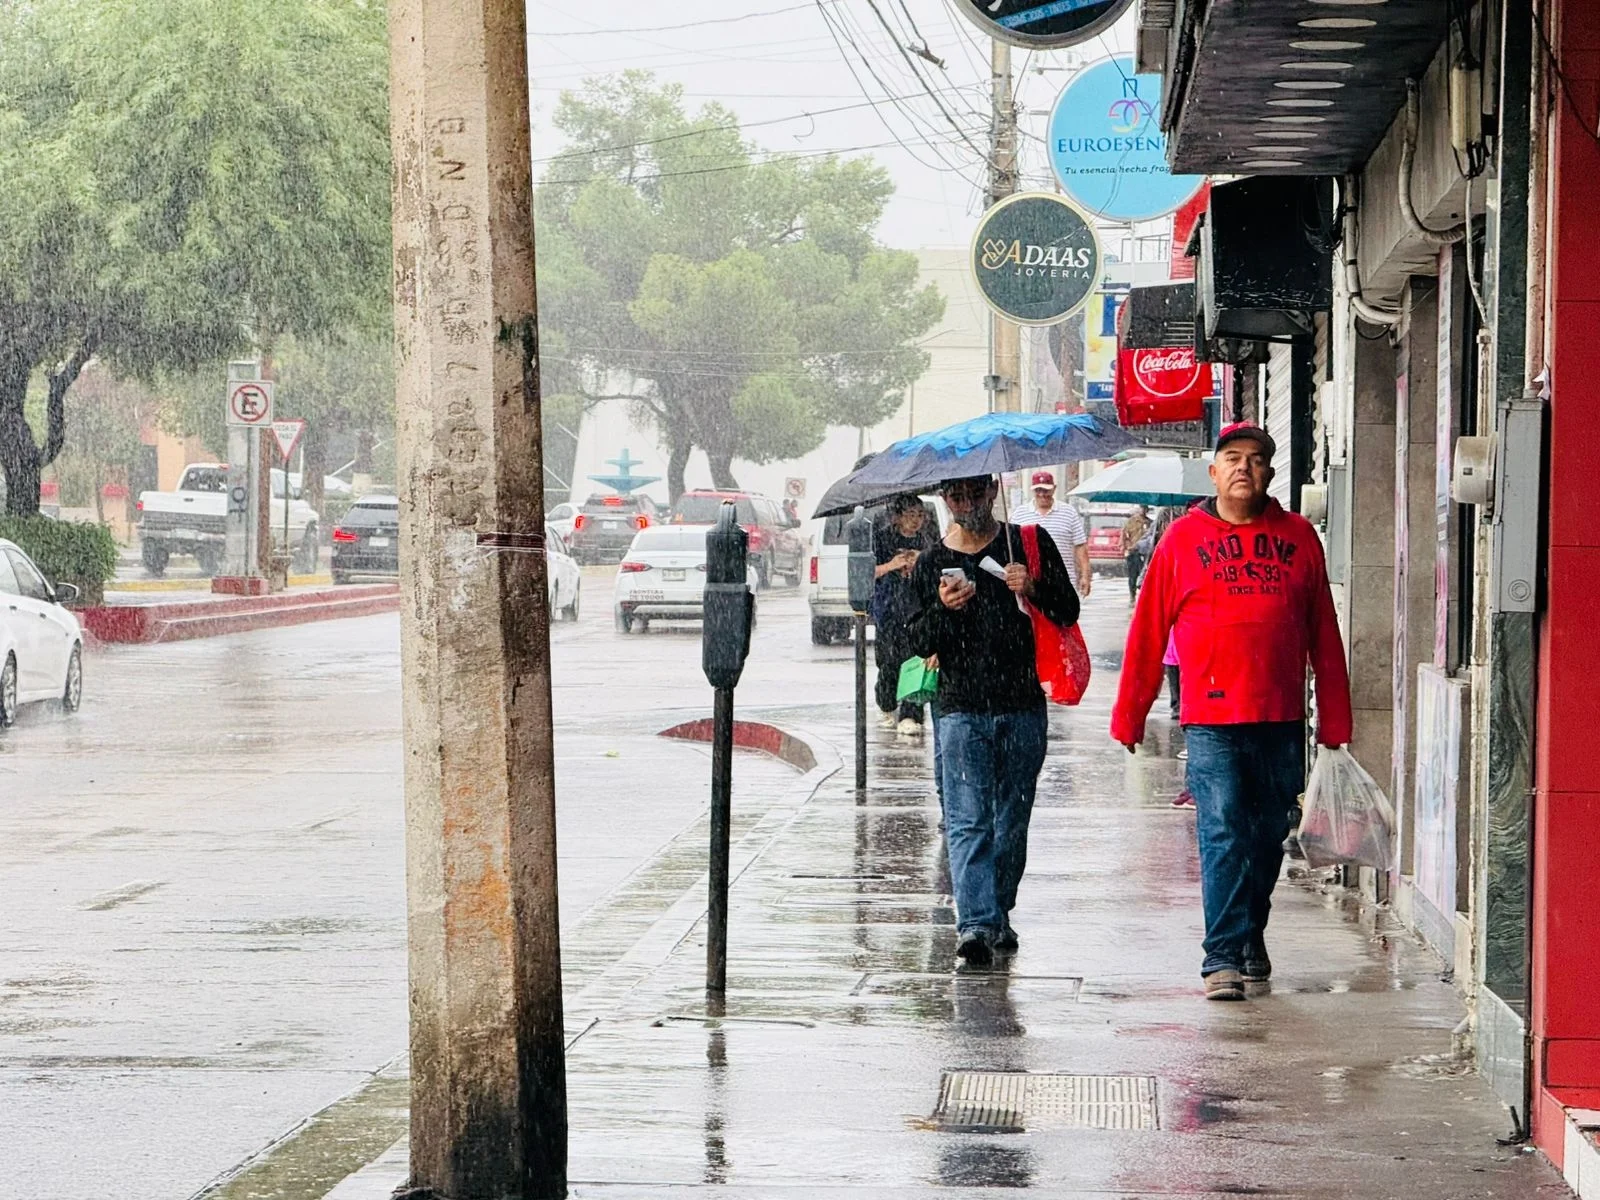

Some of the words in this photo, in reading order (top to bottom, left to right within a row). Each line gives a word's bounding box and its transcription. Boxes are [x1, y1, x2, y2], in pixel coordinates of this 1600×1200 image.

[1119, 165, 1147, 173] hecha
[983, 239, 1092, 269] ADAAS
[1015, 268, 1090, 279] JOYERIA
[241, 393, 258, 415] E
[1223, 565, 1238, 582] 19
